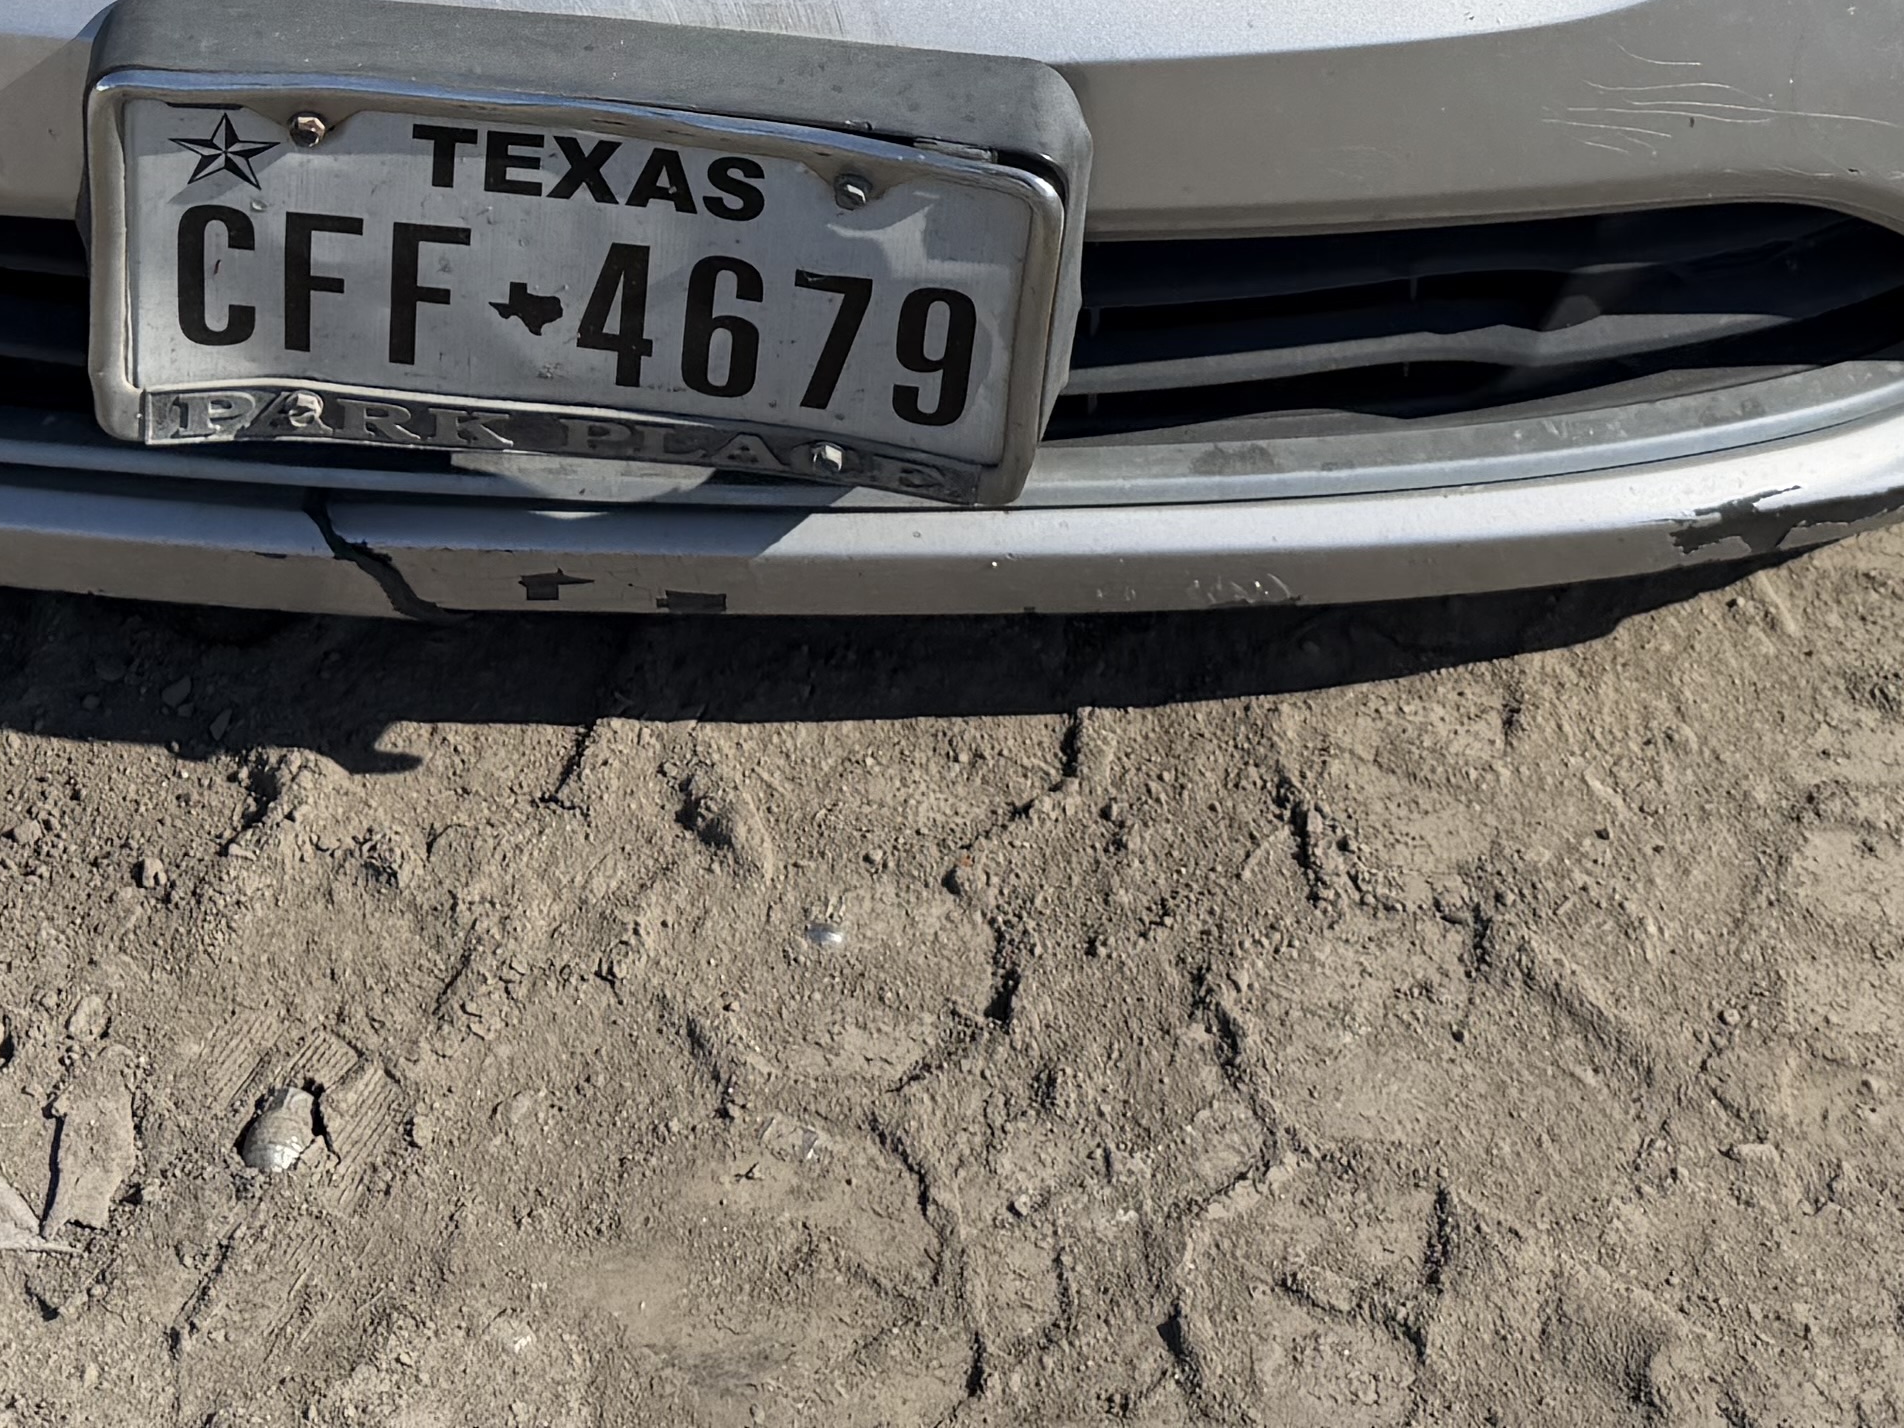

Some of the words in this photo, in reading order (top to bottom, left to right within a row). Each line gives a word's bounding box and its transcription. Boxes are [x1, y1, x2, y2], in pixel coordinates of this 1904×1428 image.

[412, 123, 766, 222] TEXAS
[176, 204, 472, 365] CFF
[575, 241, 977, 428] 4679
[168, 389, 515, 448] PARK
